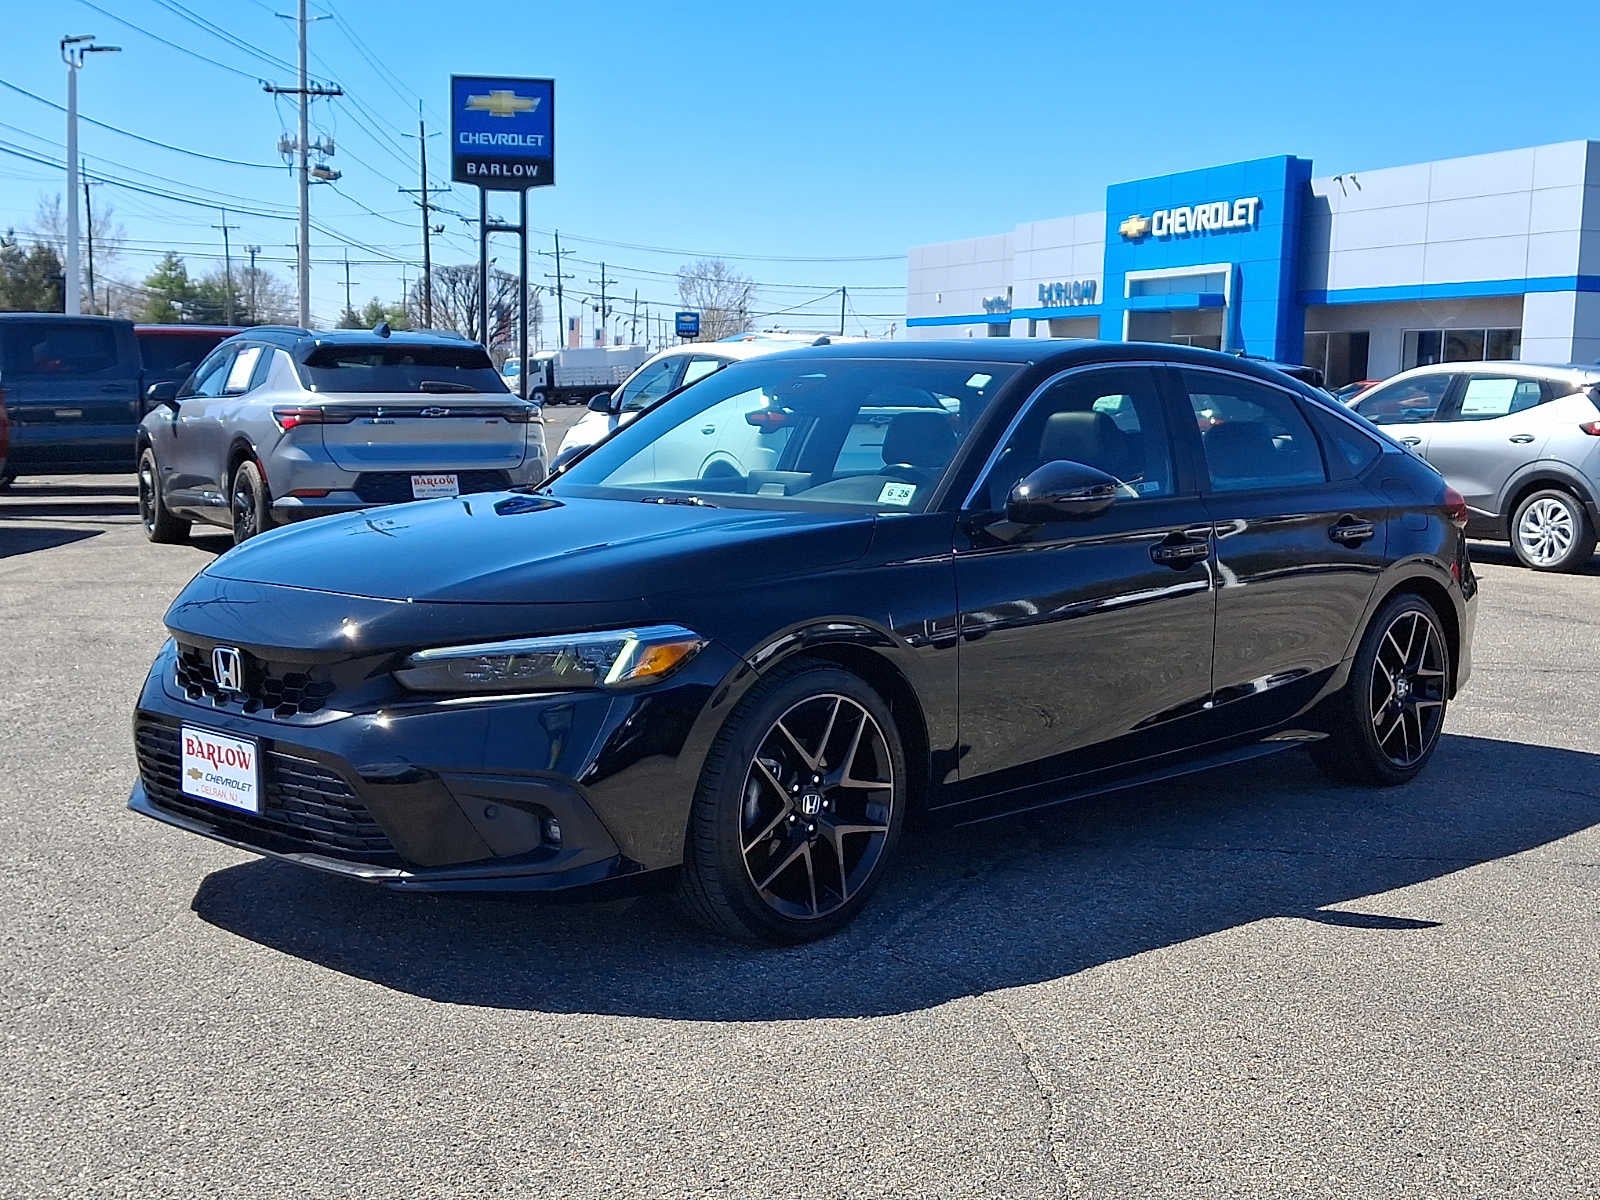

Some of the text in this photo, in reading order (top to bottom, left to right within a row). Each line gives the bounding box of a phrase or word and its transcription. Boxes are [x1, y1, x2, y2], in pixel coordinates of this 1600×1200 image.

[460, 131, 545, 147] CHEVROLET
[466, 162, 539, 177] BARLOW
[1151, 196, 1259, 237] CHEVROLET
[414, 477, 456, 487] BARLOW
[185, 737, 252, 771] BARLOW
[204, 772, 253, 793] CHEVROLET
[200, 784, 238, 802] DELRAN, NJ
